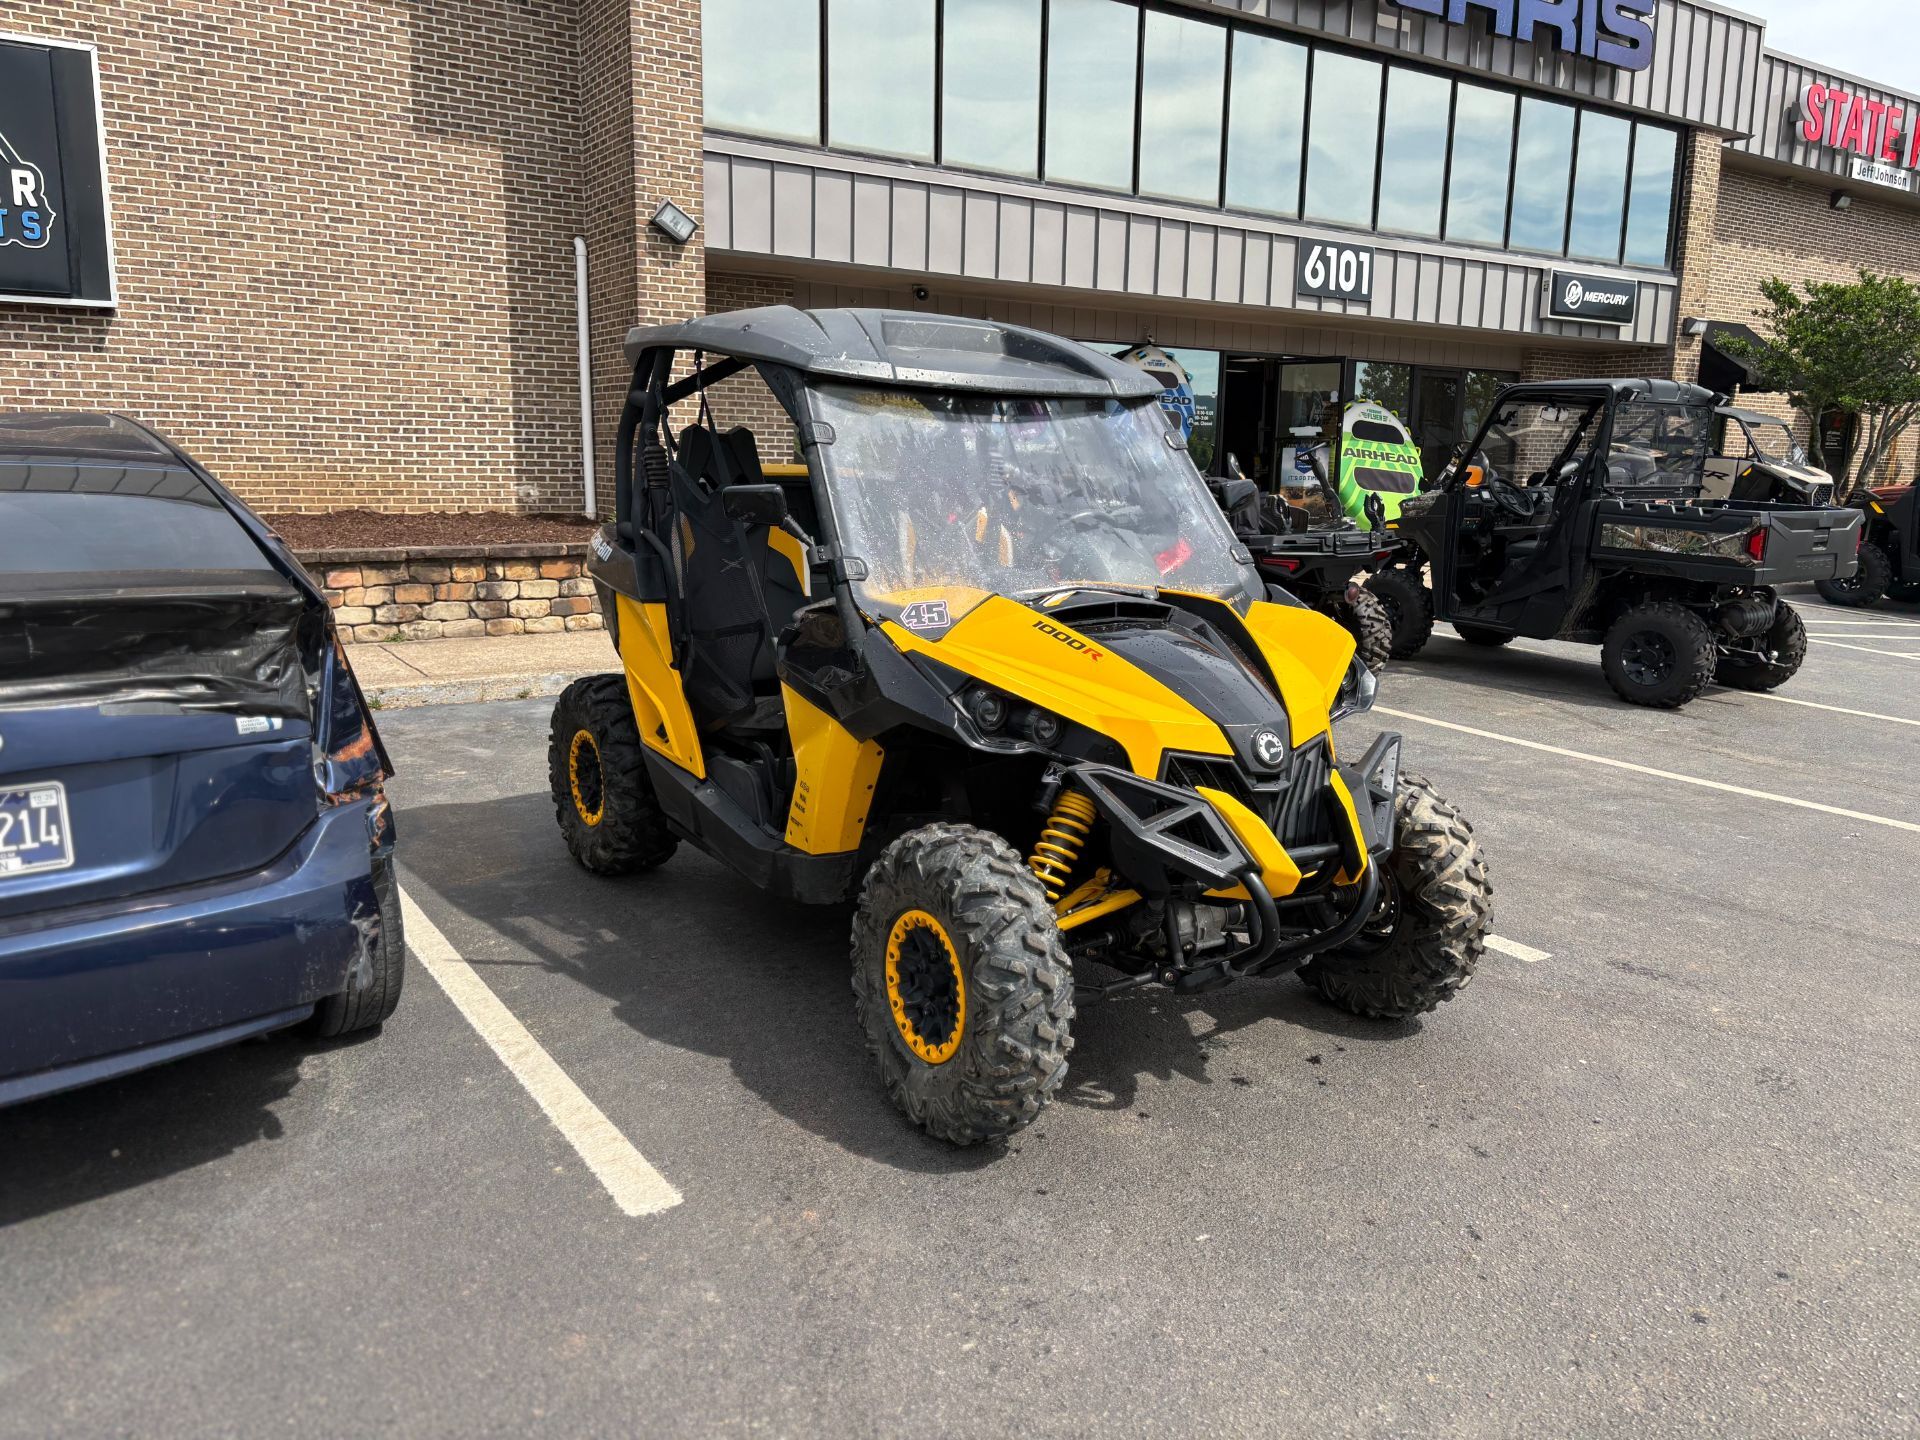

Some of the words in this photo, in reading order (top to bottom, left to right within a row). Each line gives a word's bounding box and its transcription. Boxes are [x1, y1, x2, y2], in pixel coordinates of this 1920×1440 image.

[1801, 83, 1903, 161] STATE
[1857, 165, 1874, 178] Jeff
[1875, 167, 1907, 187] Johnson
[1304, 245, 1370, 295] 6101
[1583, 291, 1629, 306] MERCURY
[1343, 447, 1418, 465] AIRHEAD
[900, 600, 951, 629] 45
[1032, 620, 1103, 662] 1000R
[0, 807, 60, 852] 214
